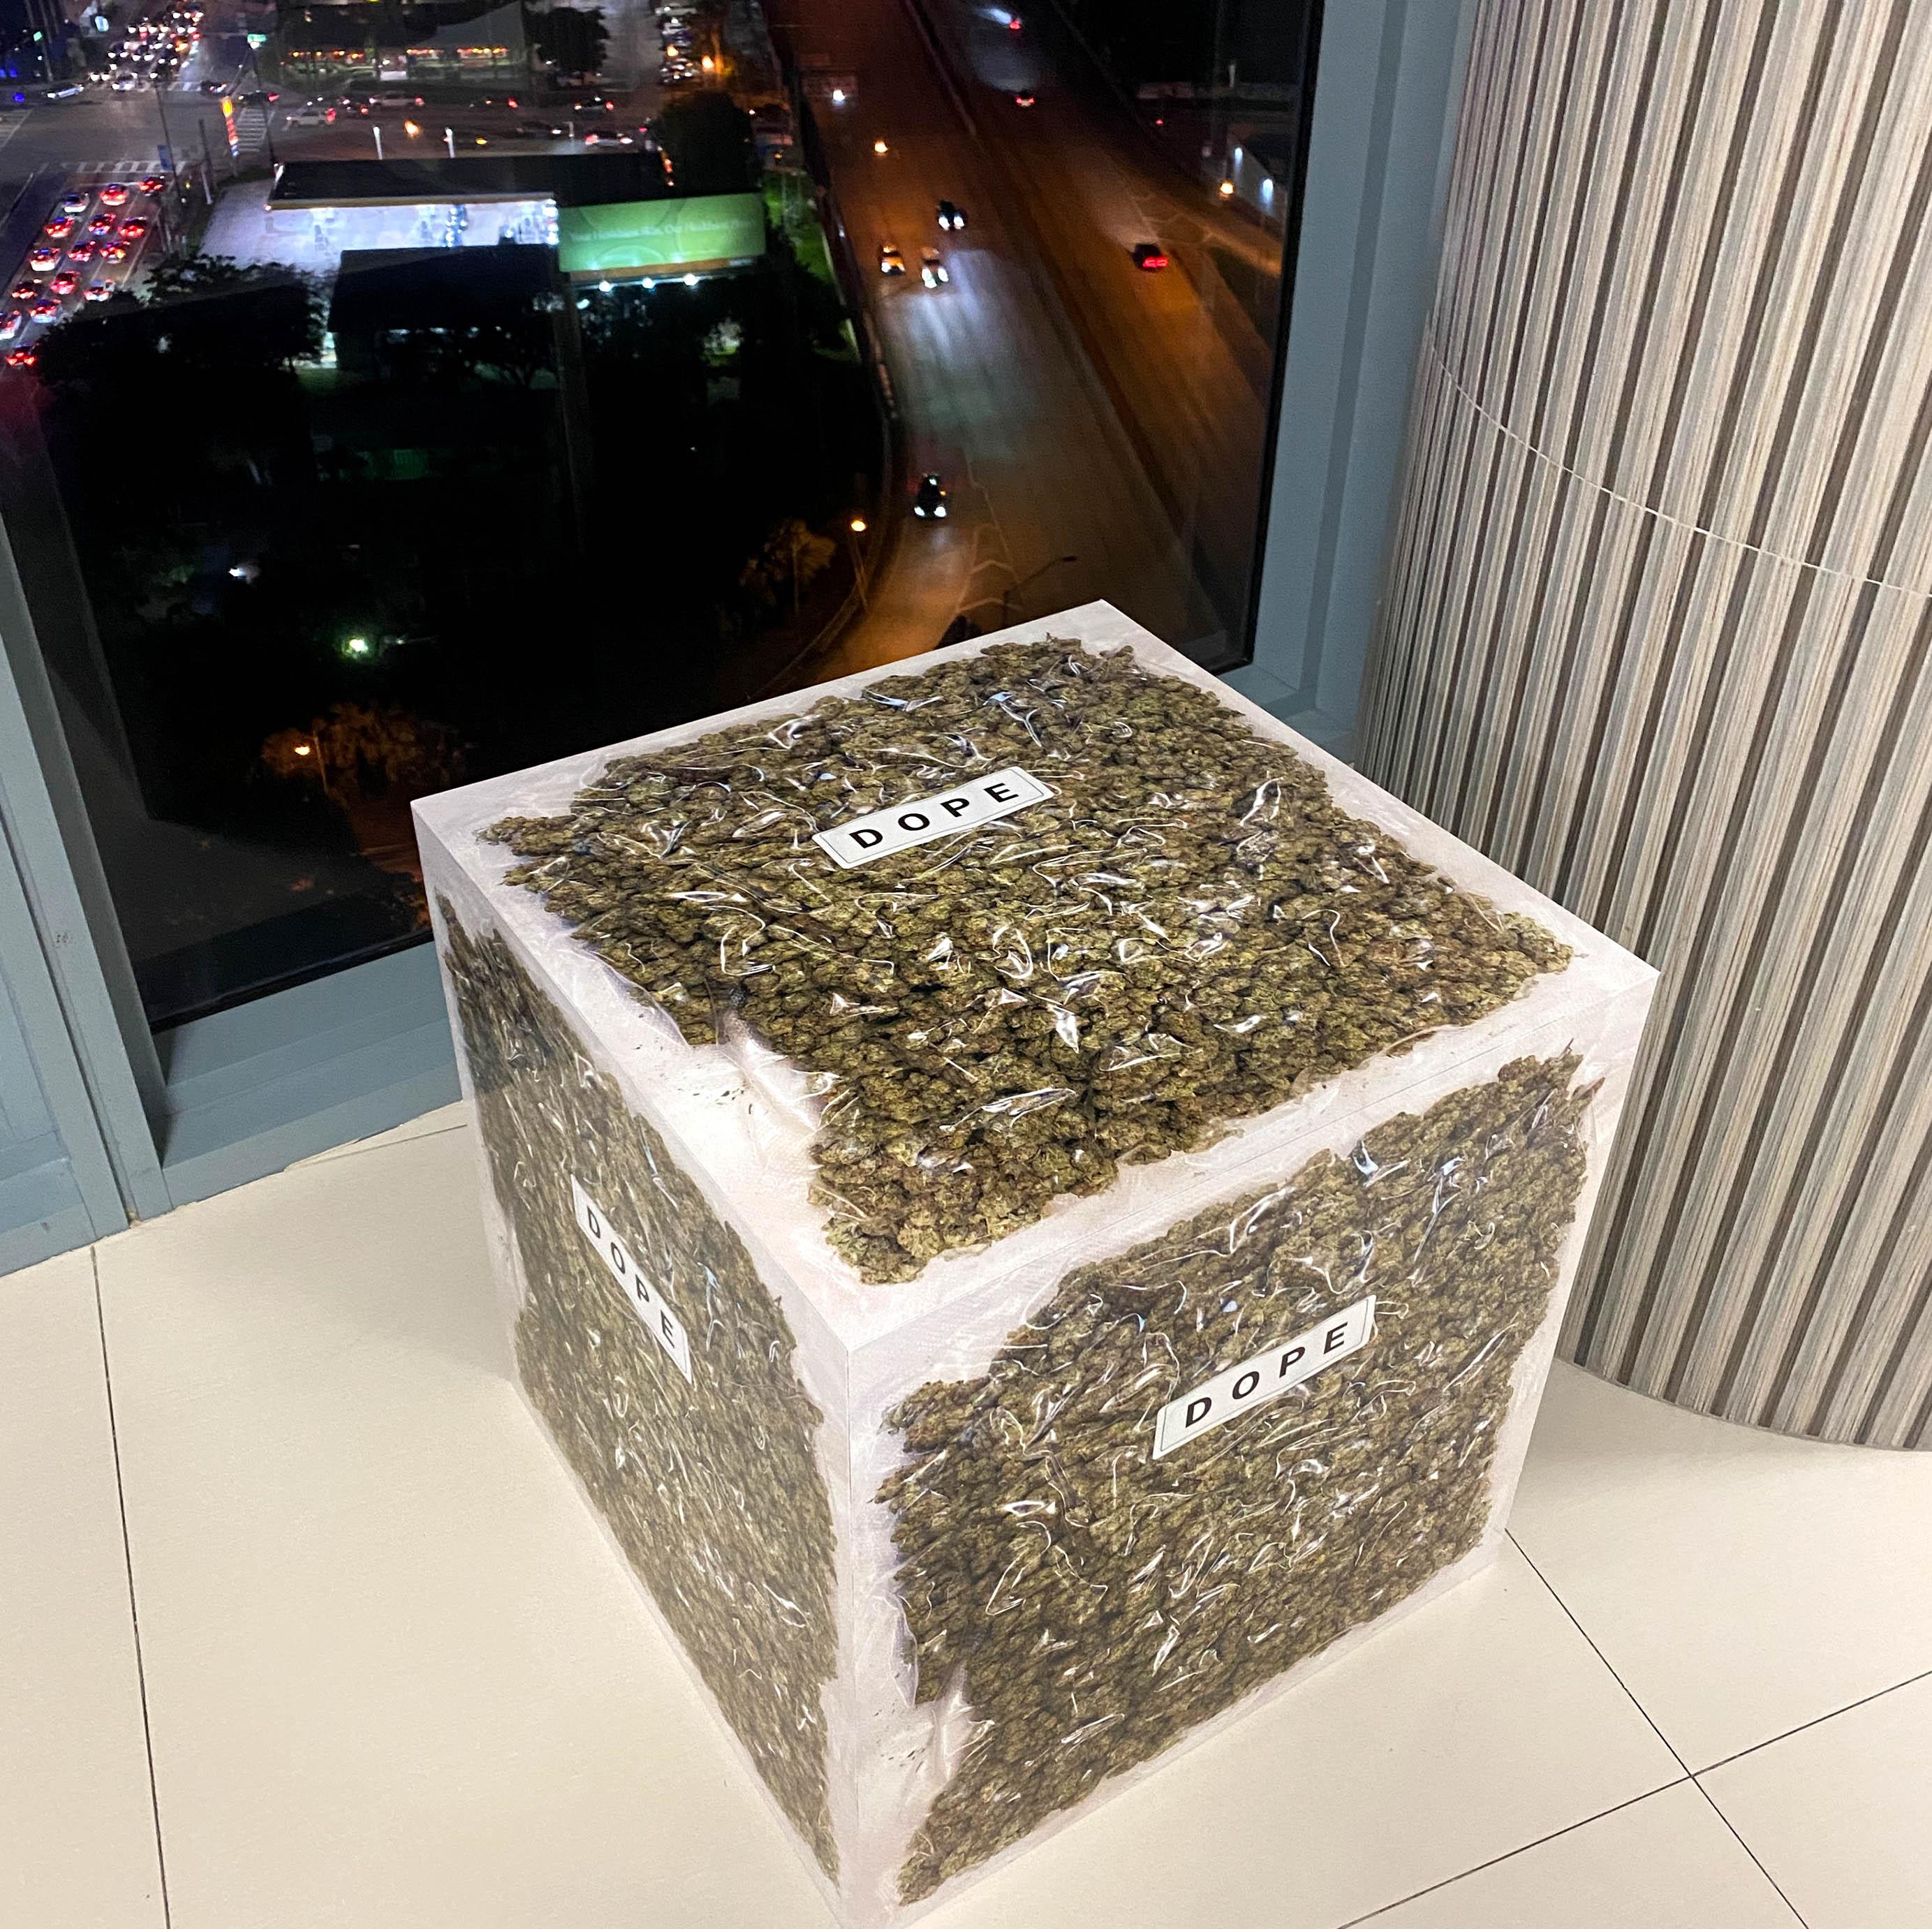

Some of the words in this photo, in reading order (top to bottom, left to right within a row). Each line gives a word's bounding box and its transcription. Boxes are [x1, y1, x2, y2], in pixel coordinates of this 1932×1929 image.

[849, 783, 1019, 849] DOPE
[587, 1206, 674, 1349] DOPE
[1186, 1322, 1348, 1428] DOPE
